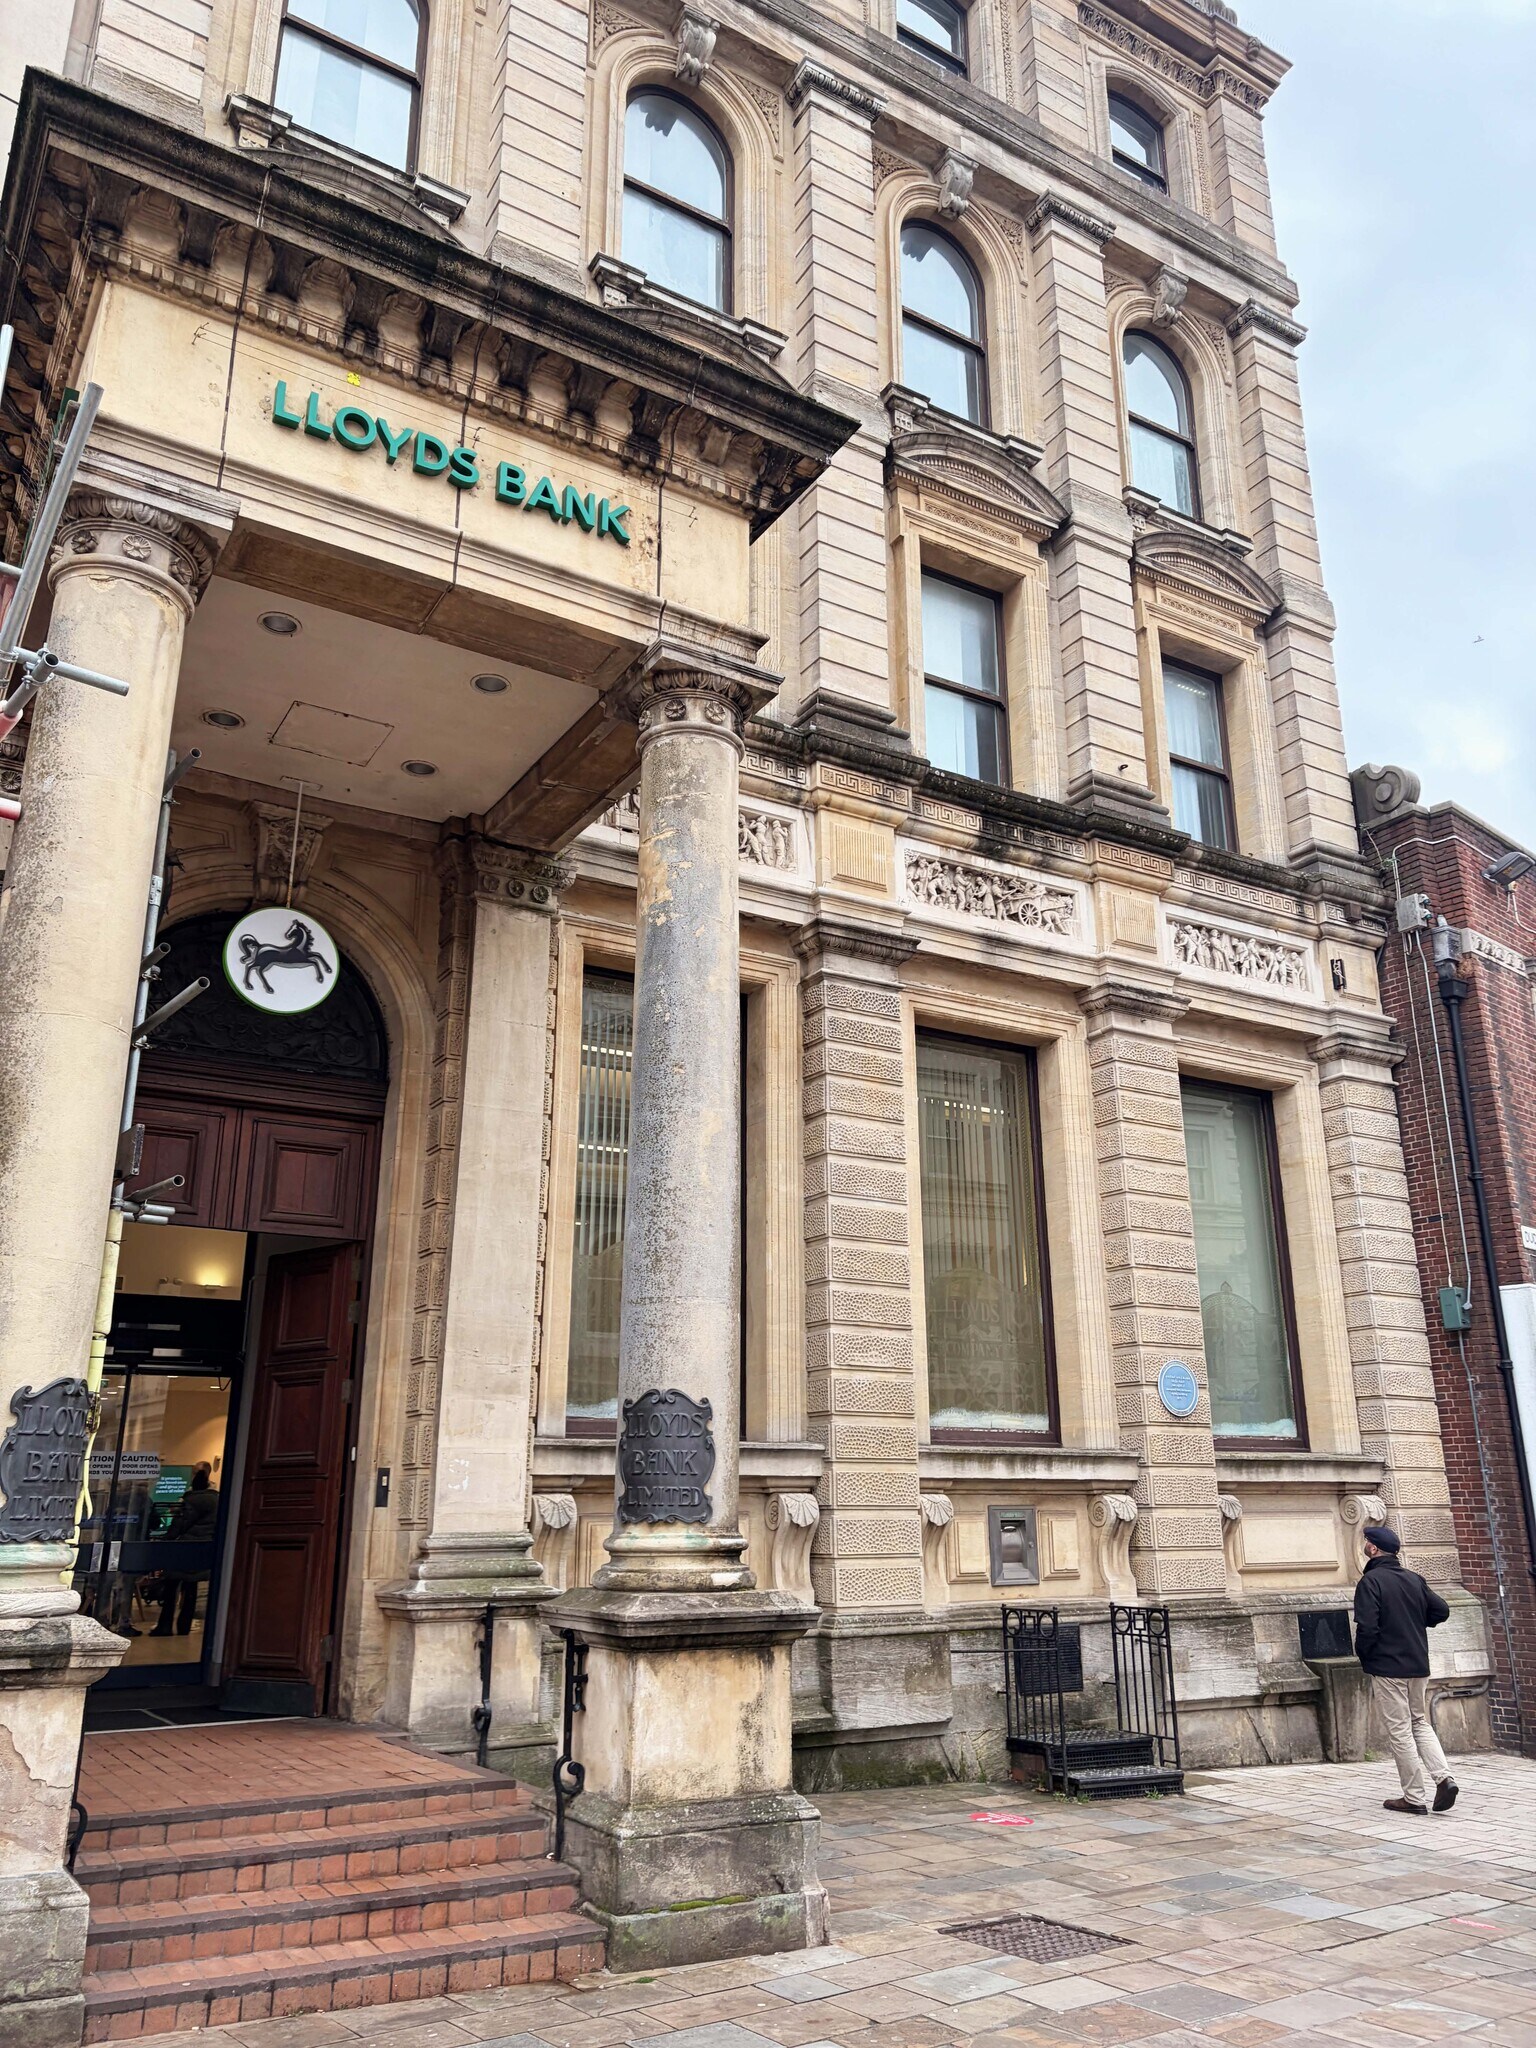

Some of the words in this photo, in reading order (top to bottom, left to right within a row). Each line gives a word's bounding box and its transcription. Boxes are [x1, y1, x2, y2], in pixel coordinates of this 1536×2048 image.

[272, 380, 480, 489] LLOYDS
[495, 461, 631, 545] BANK
[626, 1412, 706, 1438] LLOYDS
[23, 1450, 82, 1482] BAN
[631, 1449, 698, 1475] BANK
[10, 1495, 75, 1520] LIMITE
[627, 1486, 701, 1507] LIMITED
